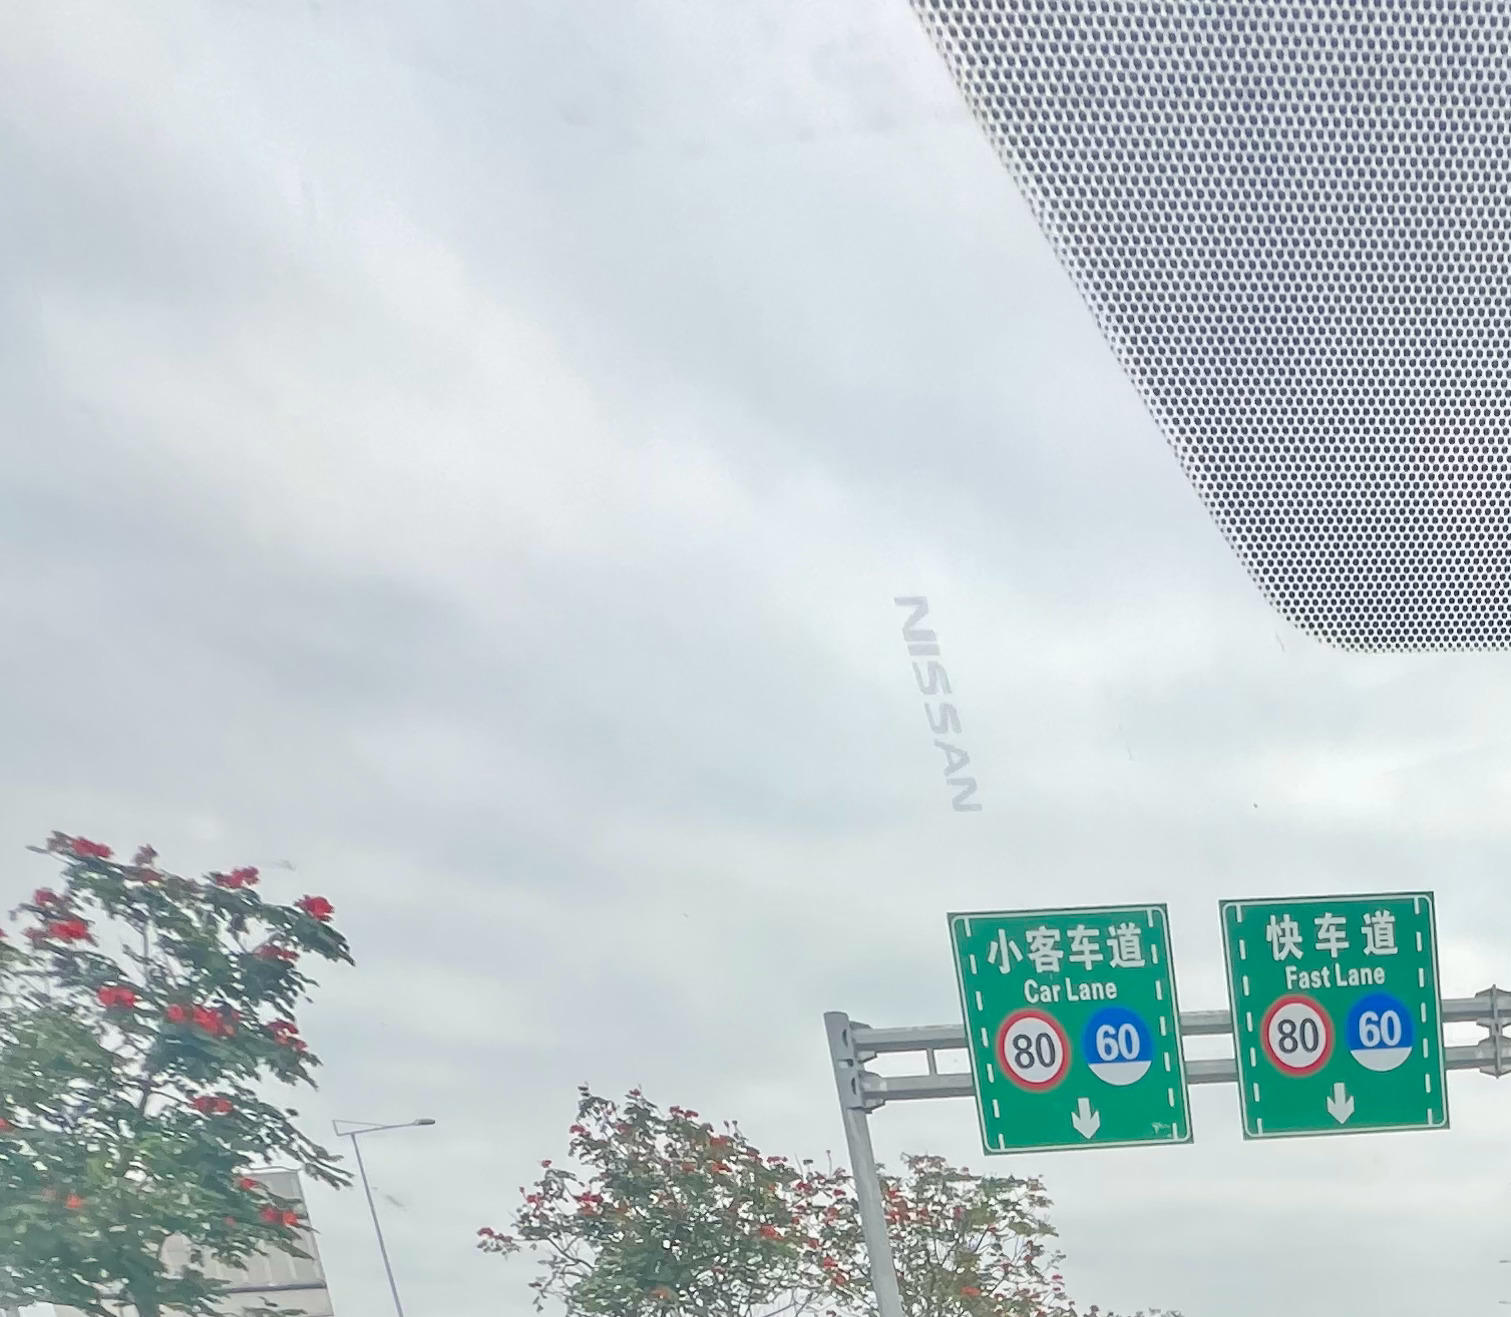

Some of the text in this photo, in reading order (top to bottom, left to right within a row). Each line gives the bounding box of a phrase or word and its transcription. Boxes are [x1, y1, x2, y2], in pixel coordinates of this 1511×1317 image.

[894, 596, 982, 811] NISSAN
[987, 922, 1145, 974] 小客车道
[1266, 910, 1397, 961] 快车道
[1024, 978, 1117, 1004] Car Lane
[1286, 963, 1385, 990] Fast Lane
[1096, 1022, 1140, 1061] 60
[1277, 1018, 1319, 1054] 80
[1358, 1010, 1402, 1047] 60
[1012, 1031, 1055, 1069] 80
